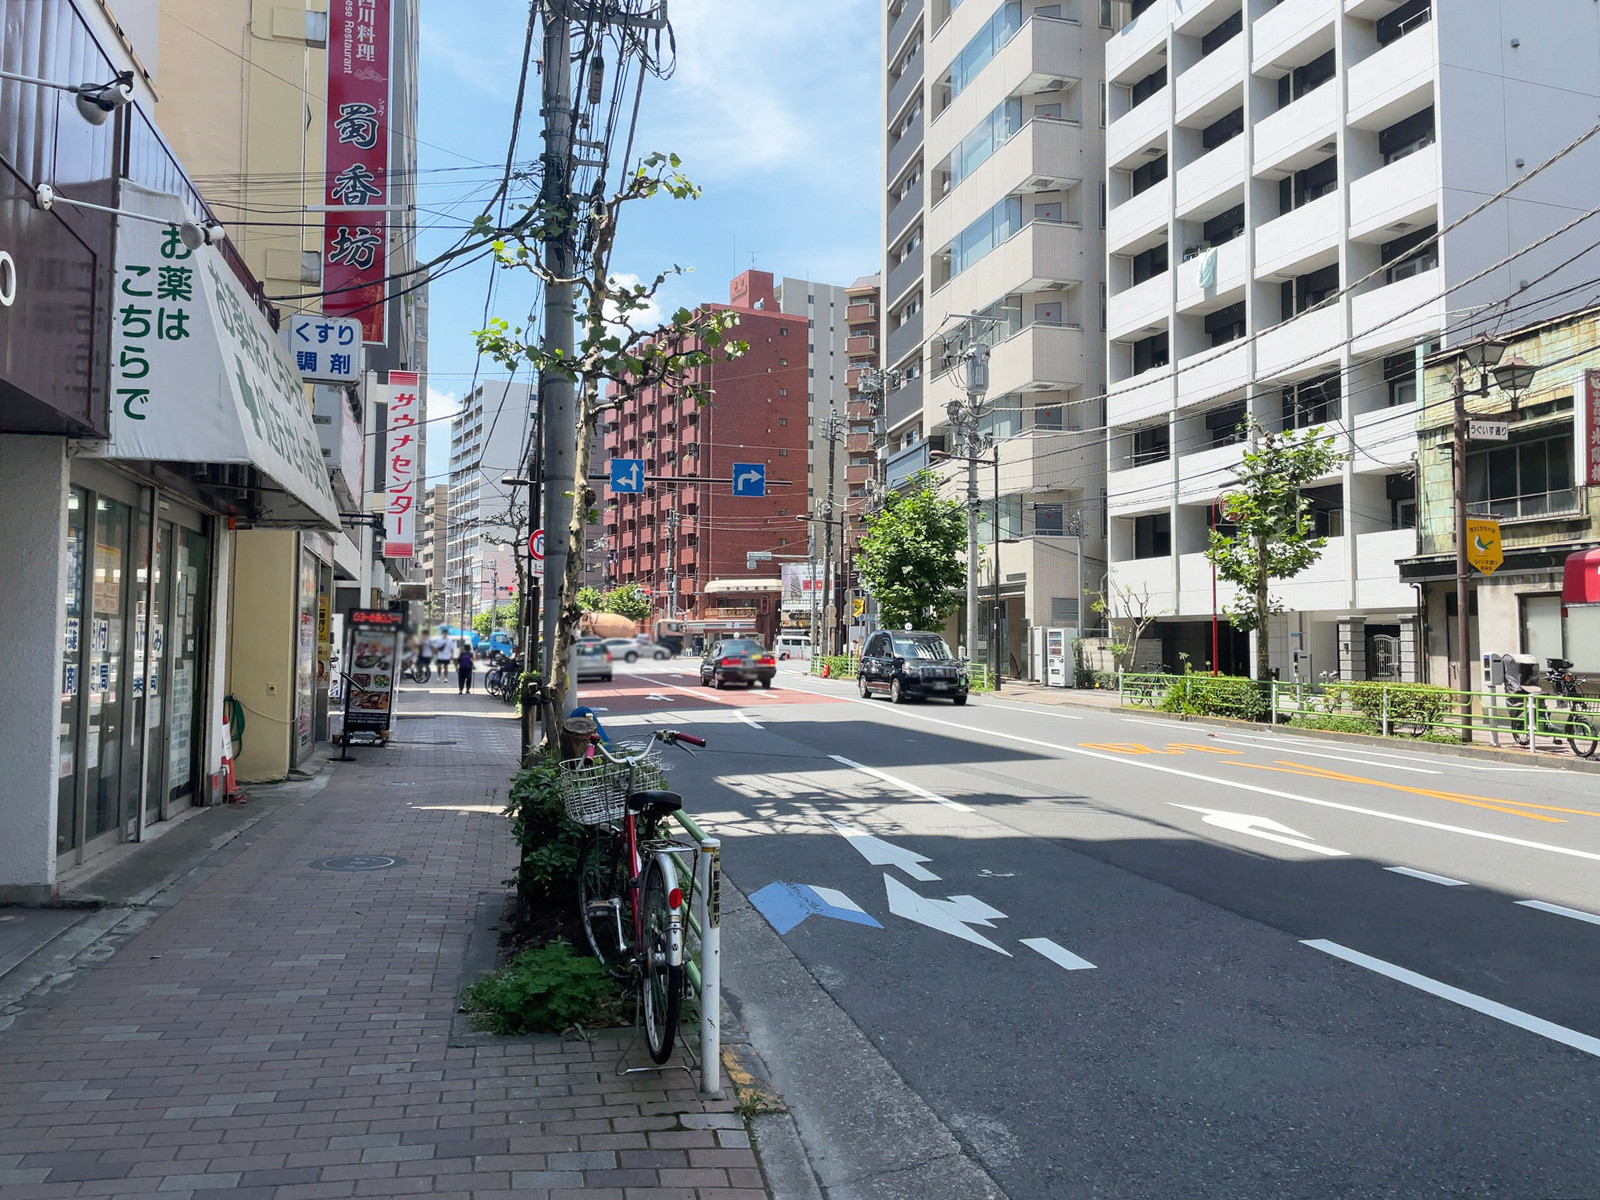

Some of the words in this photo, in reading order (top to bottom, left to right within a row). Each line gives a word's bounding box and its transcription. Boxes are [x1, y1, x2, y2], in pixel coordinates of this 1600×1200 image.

[343, 20, 354, 74] Restaurant
[157, 226, 193, 341] お薬は
[116, 265, 153, 420] こちらで
[296, 322, 354, 345] くすり
[296, 351, 351, 374] 調剤
[1470, 424, 1507, 436] うぐいす通り
[387, 393, 416, 535] サウナセンター
